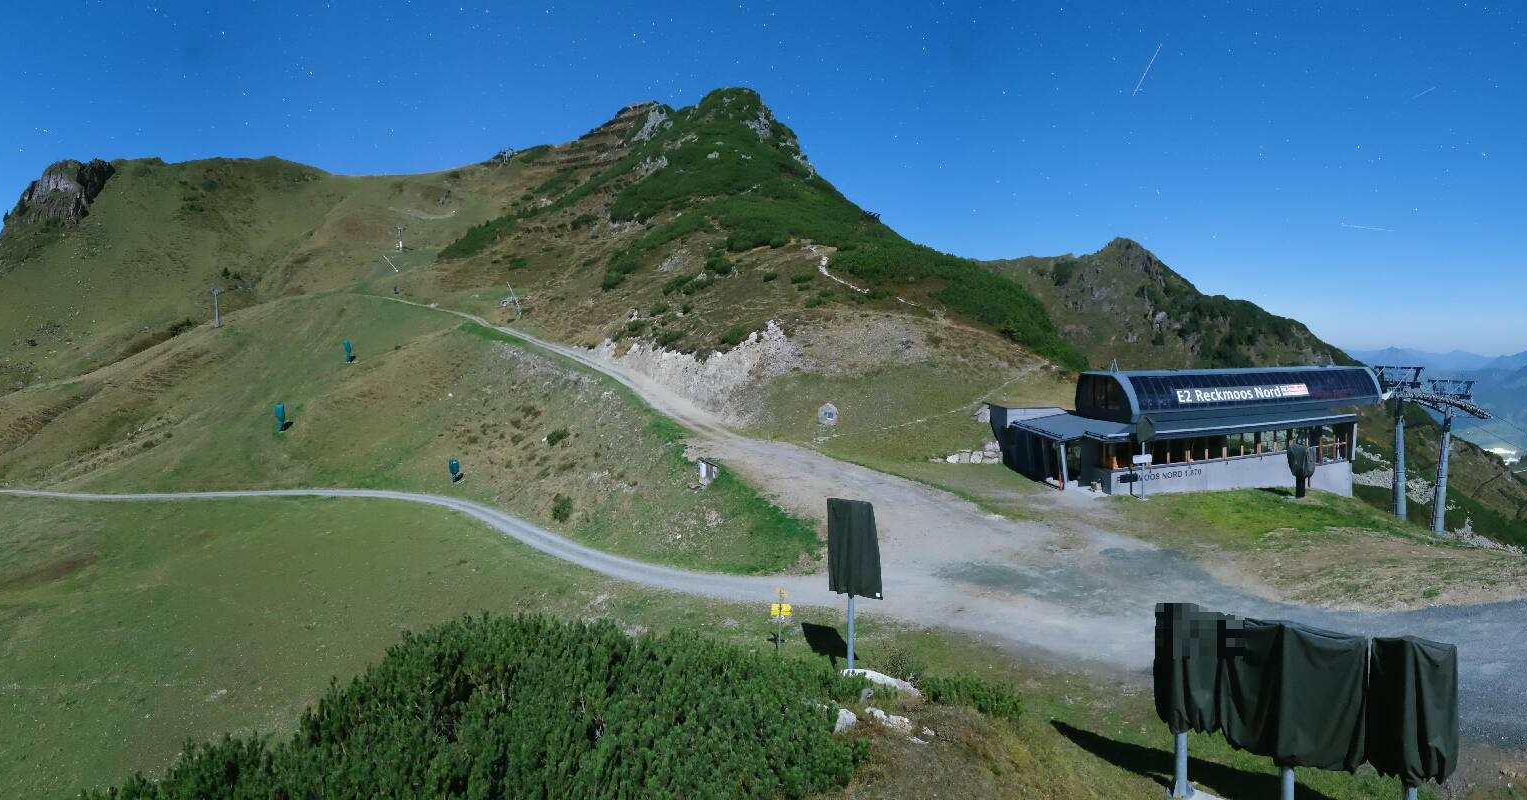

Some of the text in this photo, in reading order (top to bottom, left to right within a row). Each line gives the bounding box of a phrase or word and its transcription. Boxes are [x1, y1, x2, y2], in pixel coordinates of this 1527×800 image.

[1176, 389, 1193, 403] E2
[1196, 387, 1254, 402] Reckmoos
[1254, 385, 1282, 399] Nord
[1162, 470, 1183, 479] NORD
